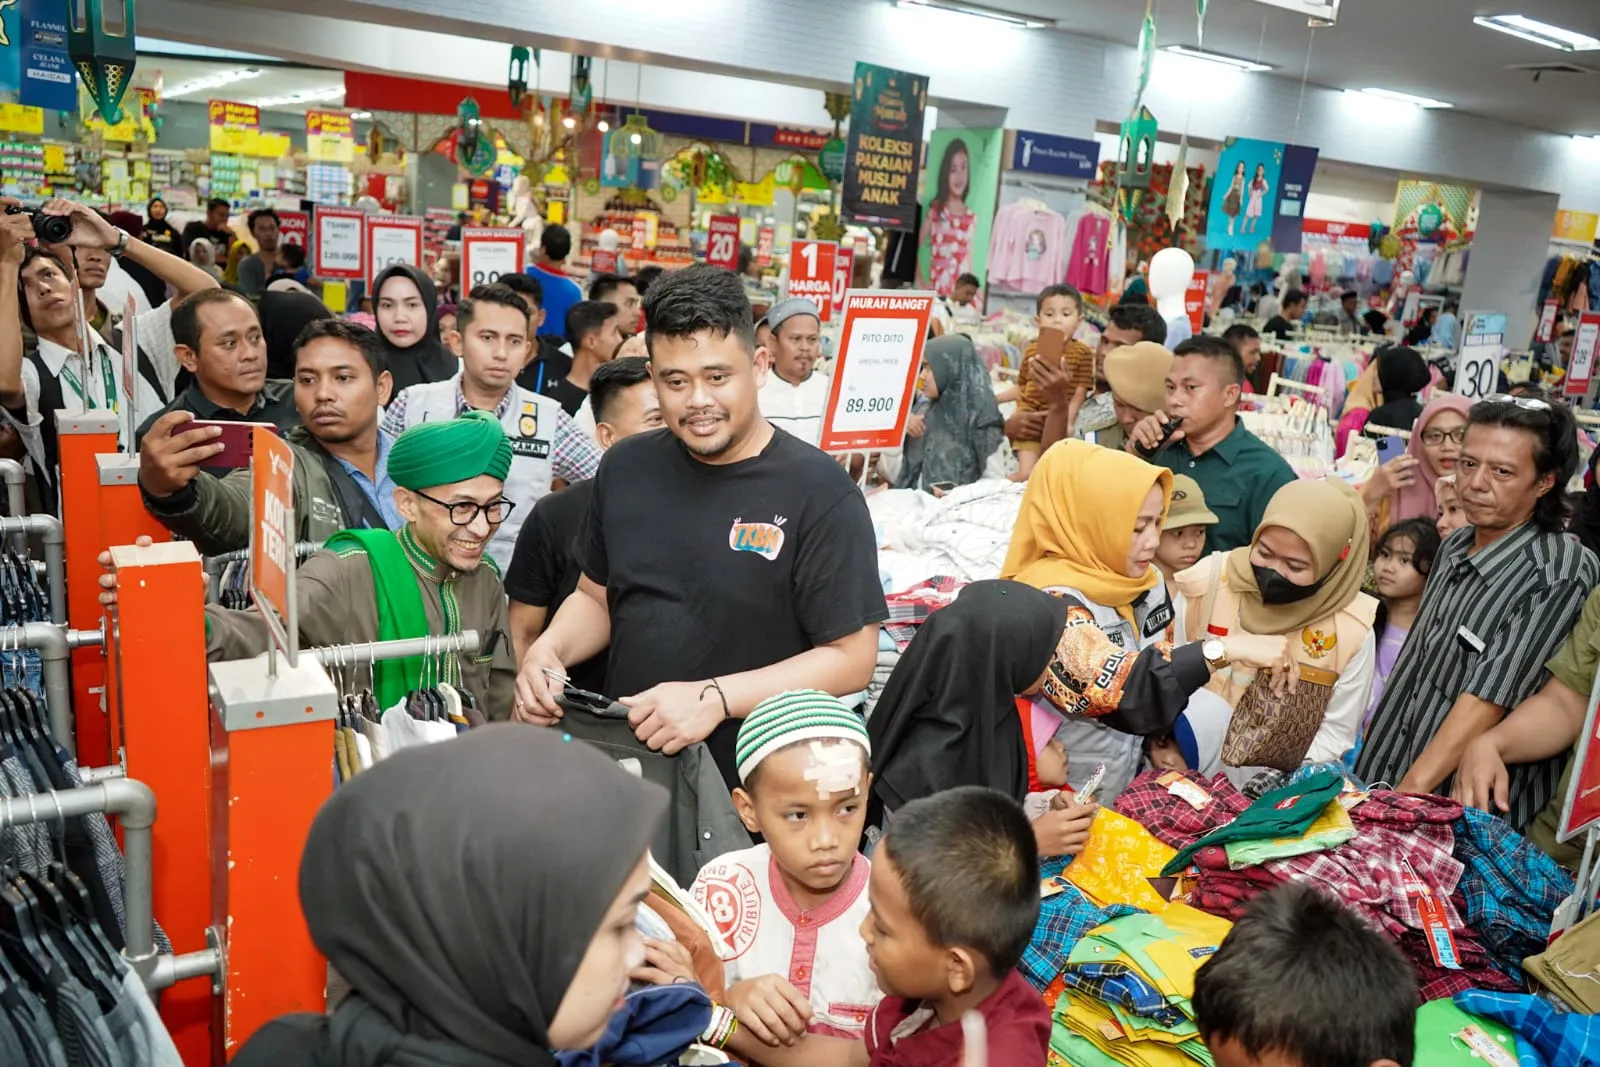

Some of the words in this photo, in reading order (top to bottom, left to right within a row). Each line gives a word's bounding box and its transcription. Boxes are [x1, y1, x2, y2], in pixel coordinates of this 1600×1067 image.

[30, 20, 68, 32] FLANNEL
[32, 53, 65, 64] CELANA
[858, 134, 913, 155] KOLEKSI
[855, 152, 913, 173] PAKAIAN
[857, 169, 907, 189] MUSLIM
[861, 188, 899, 205] ANAK
[710, 233, 735, 261] 20
[801, 243, 818, 278] 1
[789, 280, 831, 293] HARGA
[849, 297, 888, 310] MURAH
[888, 299, 929, 311] BANGET
[861, 333, 882, 343] PITO
[883, 333, 904, 343] DITO
[1461, 359, 1494, 398] 30
[845, 397, 894, 413] 89.900
[512, 442, 543, 454] CAMAT
[709, 890, 736, 923] 8
[736, 879, 758, 944] TRIBUTE
